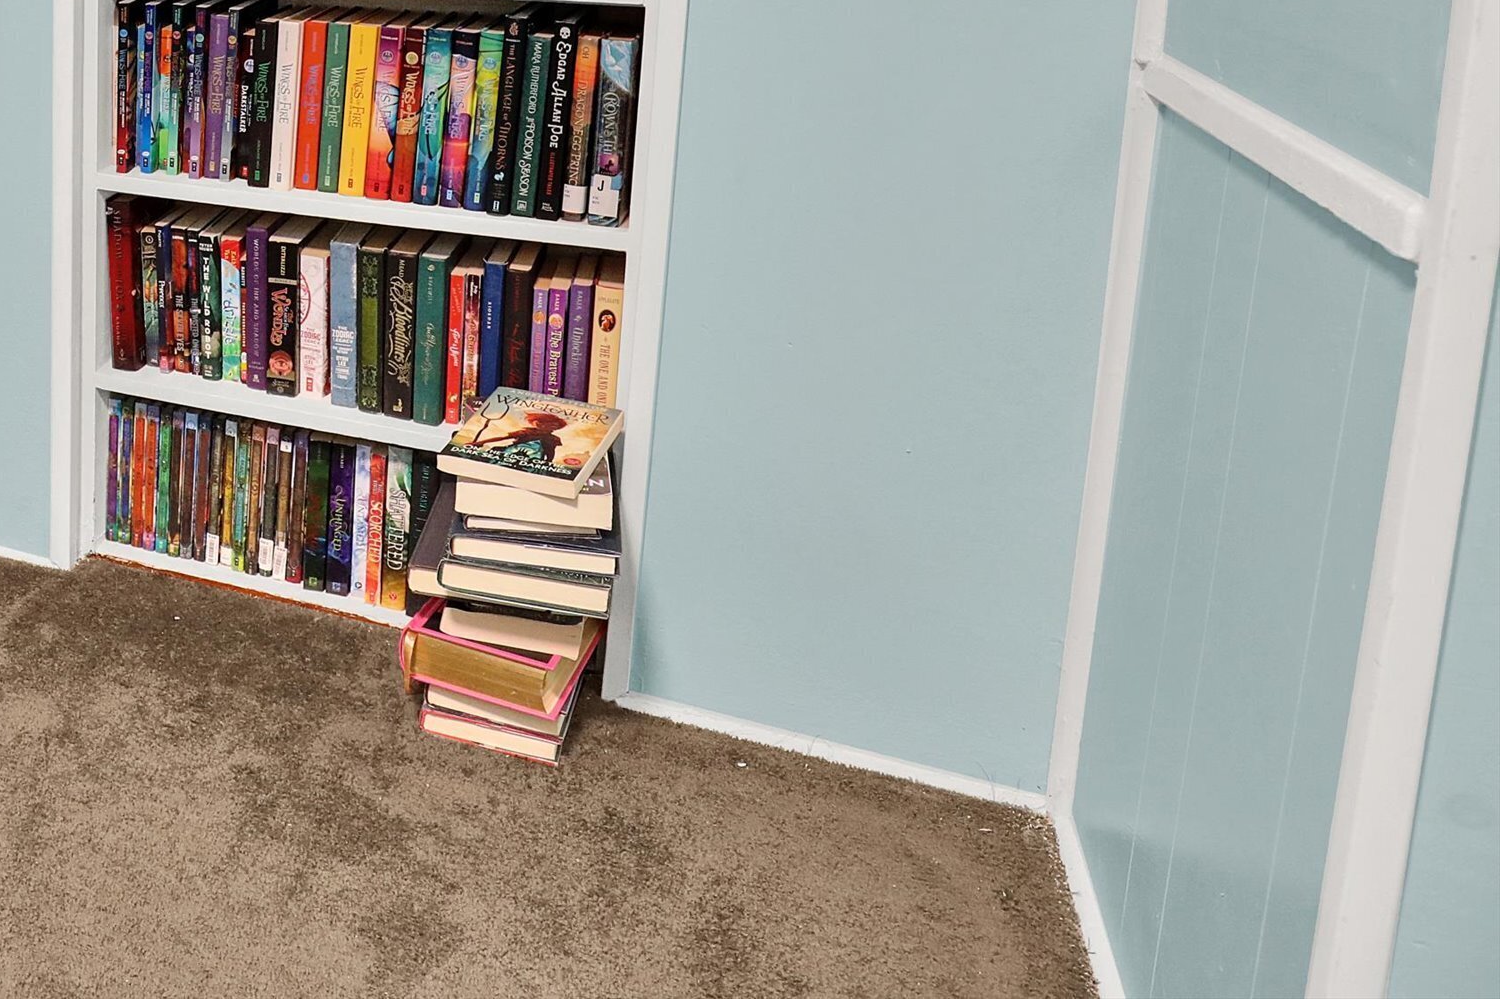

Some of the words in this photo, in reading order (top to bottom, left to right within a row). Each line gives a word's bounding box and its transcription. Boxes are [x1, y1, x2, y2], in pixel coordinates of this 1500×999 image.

[530, 41, 543, 64] MARA
[554, 40, 572, 80] EDGAR
[211, 54, 226, 85] WINGS
[255, 60, 272, 93] WINGS
[279, 62, 294, 95] WINGS
[328, 64, 344, 98] WINGS
[353, 66, 369, 99] WINGS
[501, 56, 516, 112] LANGUAGE
[211, 92, 224, 115] FIRE
[527, 64, 541, 114] RUTHERFORD
[550, 80, 568, 122] ALLAN
[572, 80, 588, 128] DRAGON
[238, 84, 250, 133] DARKSTALKER
[255, 99, 270, 123] FIRE
[278, 101, 293, 125] FIRE
[327, 104, 342, 128] FIRE
[351, 105, 366, 129] FIRE
[494, 121, 512, 171] THORNS
[521, 122, 536, 160] POISON
[547, 123, 564, 149] POE
[571, 128, 584, 151] EGG
[516, 159, 531, 198] SEASON
[567, 152, 583, 186] PRINC
[202, 256, 211, 281] THE
[202, 284, 211, 317] WILD
[202, 318, 212, 360] ROBOT
[550, 330, 561, 348] The
[599, 344, 611, 358] THE
[547, 350, 560, 386] Bravest
[599, 359, 609, 374] ONE
[596, 391, 607, 405] ONL
[368, 499, 383, 563] SCORCHED
[386, 487, 407, 571] SHATTERED
